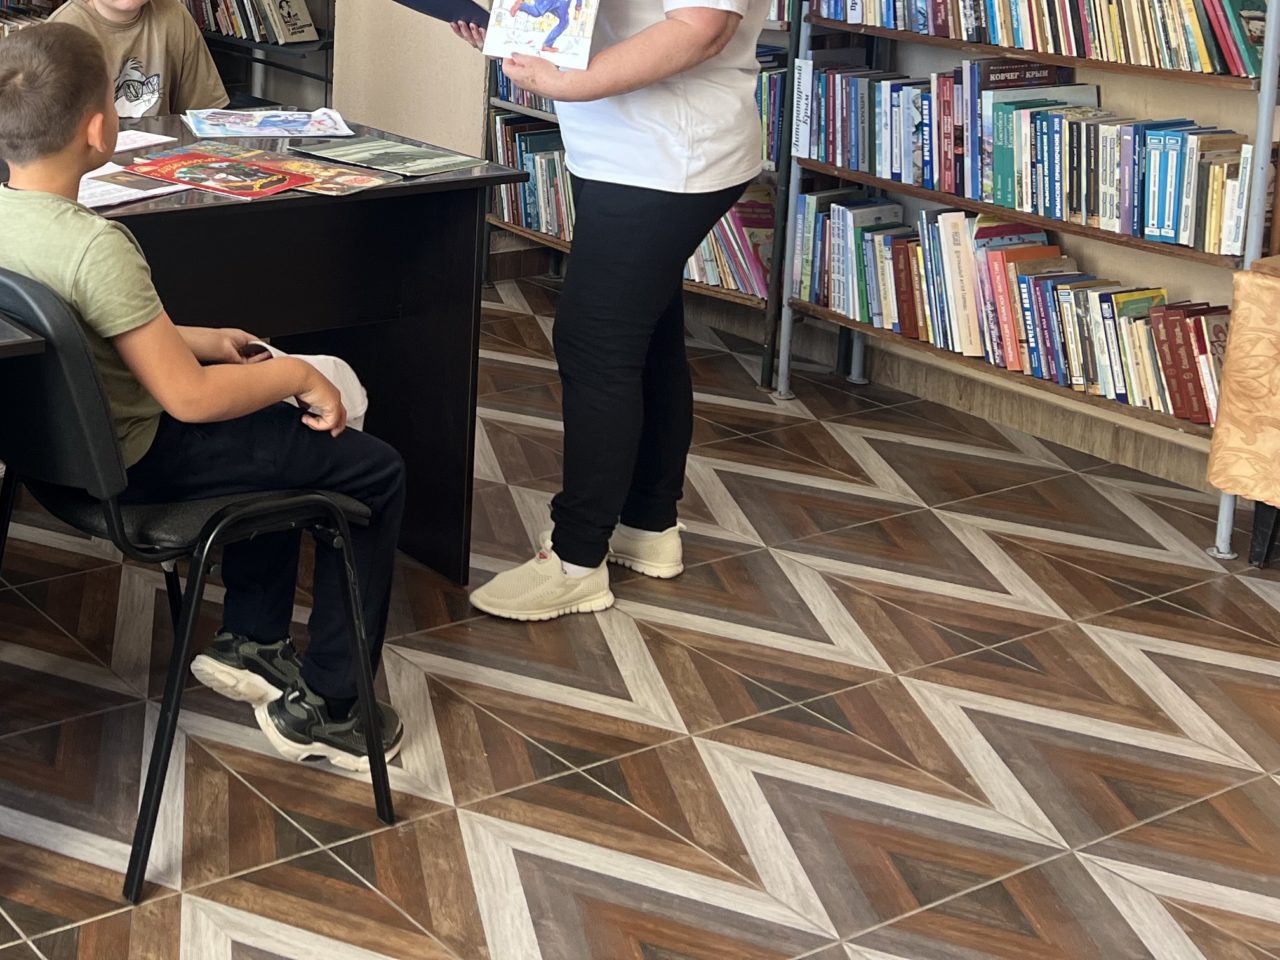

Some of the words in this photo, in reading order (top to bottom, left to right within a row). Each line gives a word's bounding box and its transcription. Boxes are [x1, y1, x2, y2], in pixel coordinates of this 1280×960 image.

[989, 72, 1020, 81] КОВЧЕГ
[1025, 70, 1049, 79] КРЫМ
[792, 65, 803, 152] Литературный
[802, 94, 811, 126] Крым
[986, 300, 996, 329] ИСТОРИИ
[1024, 311, 1035, 348] ВЯЧЕСЛАВ
[991, 329, 1000, 363] КРЫМСКИЕ
